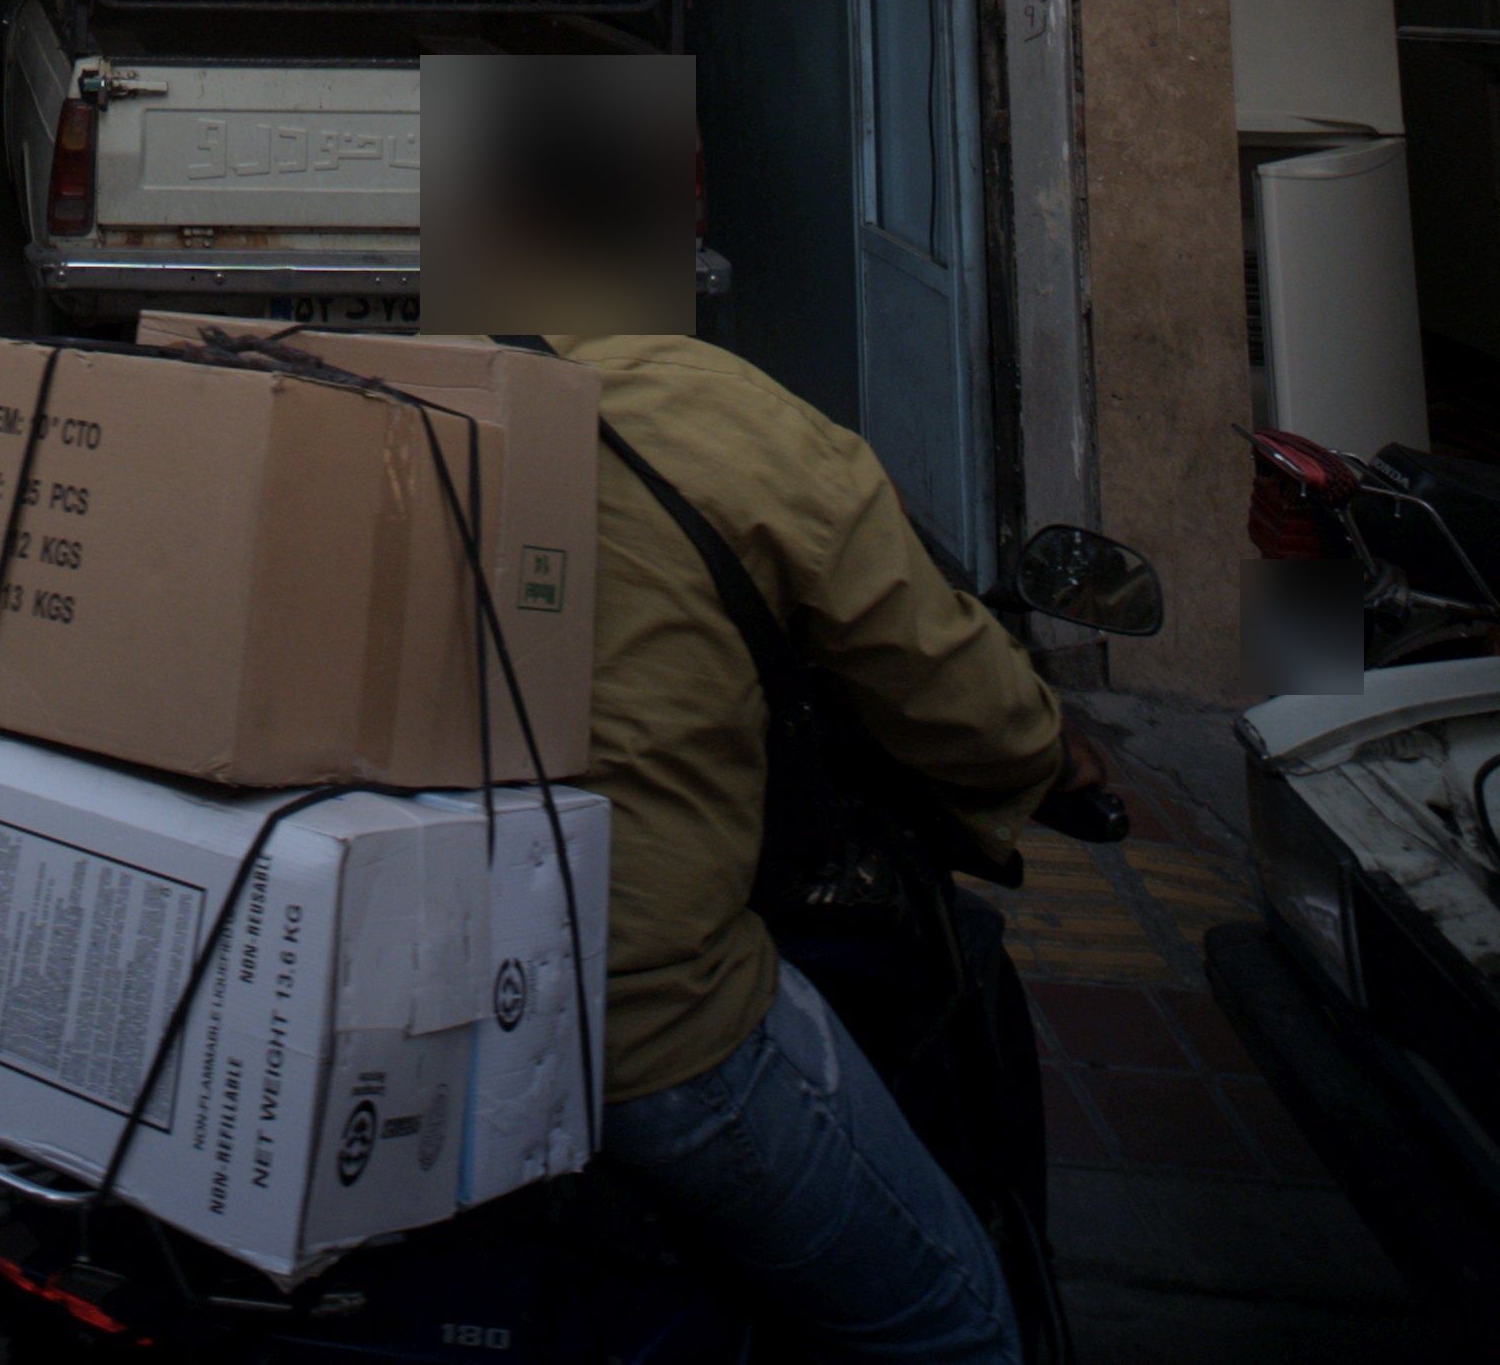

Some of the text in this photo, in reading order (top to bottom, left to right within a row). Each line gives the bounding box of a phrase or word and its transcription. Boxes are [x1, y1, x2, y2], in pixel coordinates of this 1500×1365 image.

[61, 417, 102, 451] CTO
[50, 481, 90, 516] PCS
[40, 535, 83, 570] KGS
[32, 589, 76, 625] KGS
[209, 854, 274, 1215] NON-REFILLABLE NON-REUSABLE
[251, 904, 303, 1190] NET WEIGHT 13.6 KG
[439, 1322, 512, 1350] 180
